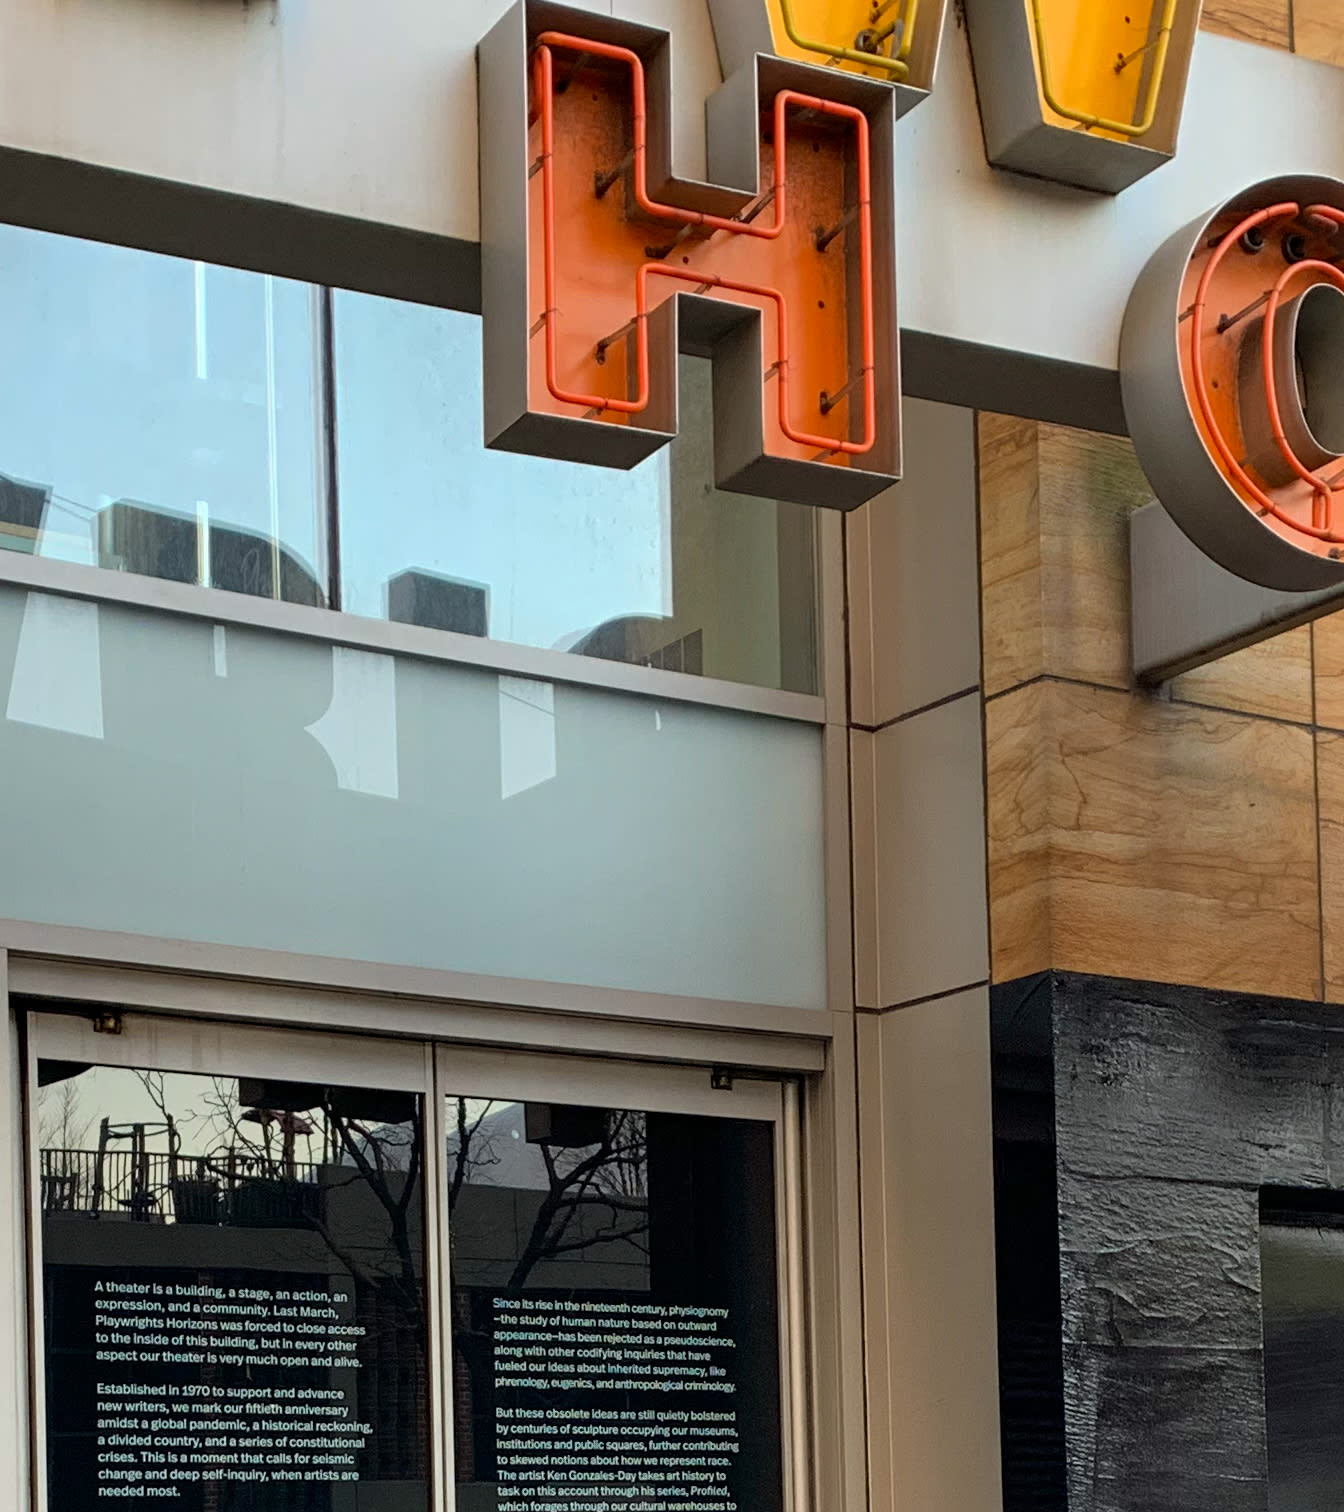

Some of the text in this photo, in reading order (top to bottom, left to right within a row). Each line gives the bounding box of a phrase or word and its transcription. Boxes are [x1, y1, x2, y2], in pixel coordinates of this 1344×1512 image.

[94, 1280, 103, 1290] A
[105, 1280, 150, 1292] theater
[152, 1282, 163, 1293] is
[175, 1283, 226, 1299] building,
[238, 1286, 273, 1301] stage,
[275, 1291, 290, 1299] an
[292, 1289, 331, 1303] action,
[94, 1297, 165, 1313] expression,
[167, 1300, 190, 1311] and
[202, 1301, 270, 1318] community.
[273, 1304, 298, 1315] Last
[300, 1305, 339, 1319] March,
[95, 1314, 366, 1334] Playwrights Horizons was forced to close access
[95, 1331, 357, 1352] to the inside of this building, but in every other
[95, 1348, 137, 1363] aspect
[161, 1350, 205, 1362] theater
[207, 1351, 217, 1362] is
[219, 1355, 244, 1366] very
[245, 1352, 278, 1364] much
[279, 1357, 308, 1368] open
[310, 1354, 332, 1365] and
[333, 1355, 362, 1366] alive.
[495, 1406, 735, 1423] But these obsolete ideas are still quietly bolstered
[496, 1438, 739, 1453] institutions and public squares, further contributing
